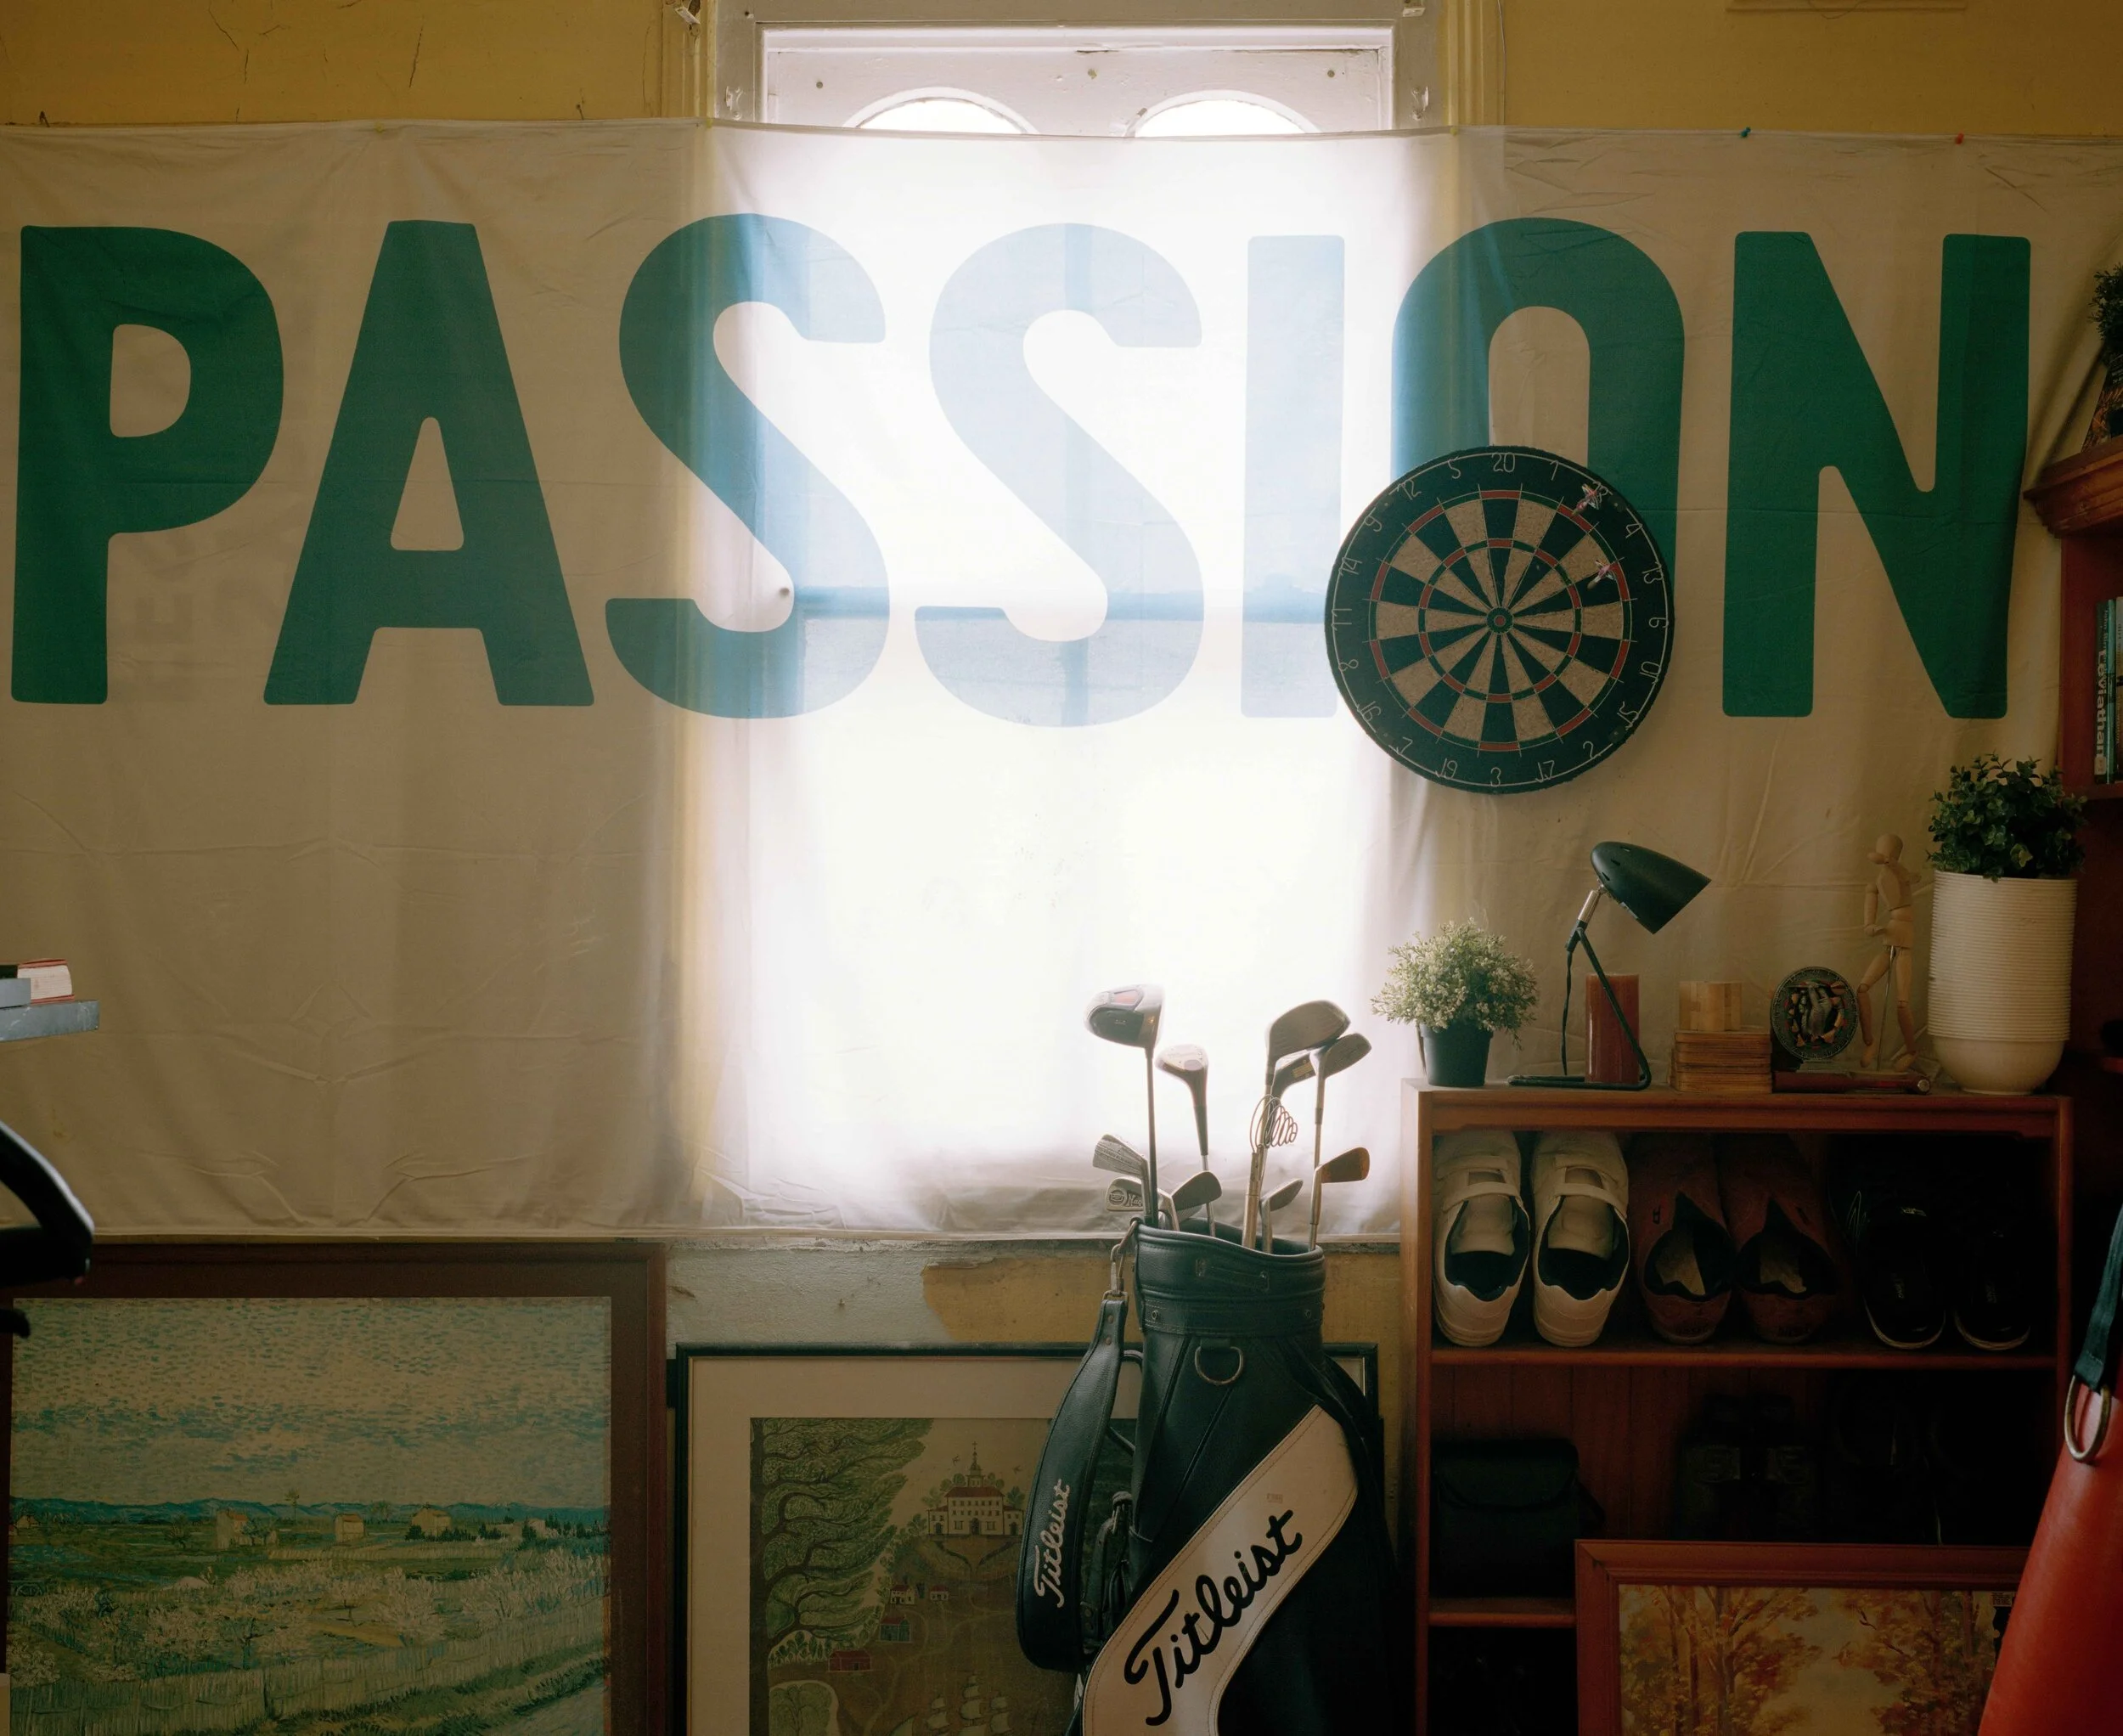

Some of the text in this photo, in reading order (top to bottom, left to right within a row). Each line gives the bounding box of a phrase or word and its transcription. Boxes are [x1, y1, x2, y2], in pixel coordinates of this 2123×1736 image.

[11, 213, 2030, 729] PASSION
[1448, 456, 1461, 479] 5
[1491, 452, 1515, 472] 20
[1395, 479, 1422, 500] 12
[1365, 513, 1382, 532] 9
[1625, 521, 1643, 538] 4
[1338, 556, 1362, 576] 14
[1642, 562, 1664, 583] 13
[1332, 608, 1352, 629] 11
[1338, 658, 1359, 672] 8
[1639, 661, 1662, 681] 10
[1359, 701, 1382, 724] 16
[2096, 650, 2107, 757] Leviathan
[1617, 702, 1639, 730] 15
[1395, 736, 1413, 756] 7
[1583, 741, 1601, 758] 2
[1436, 758, 1458, 780] 19
[1490, 768, 1501, 786] 3
[1535, 760, 1555, 783] 17
[1034, 1479, 1070, 1608] Titleist
[1124, 1509, 1303, 1726] Titleist
